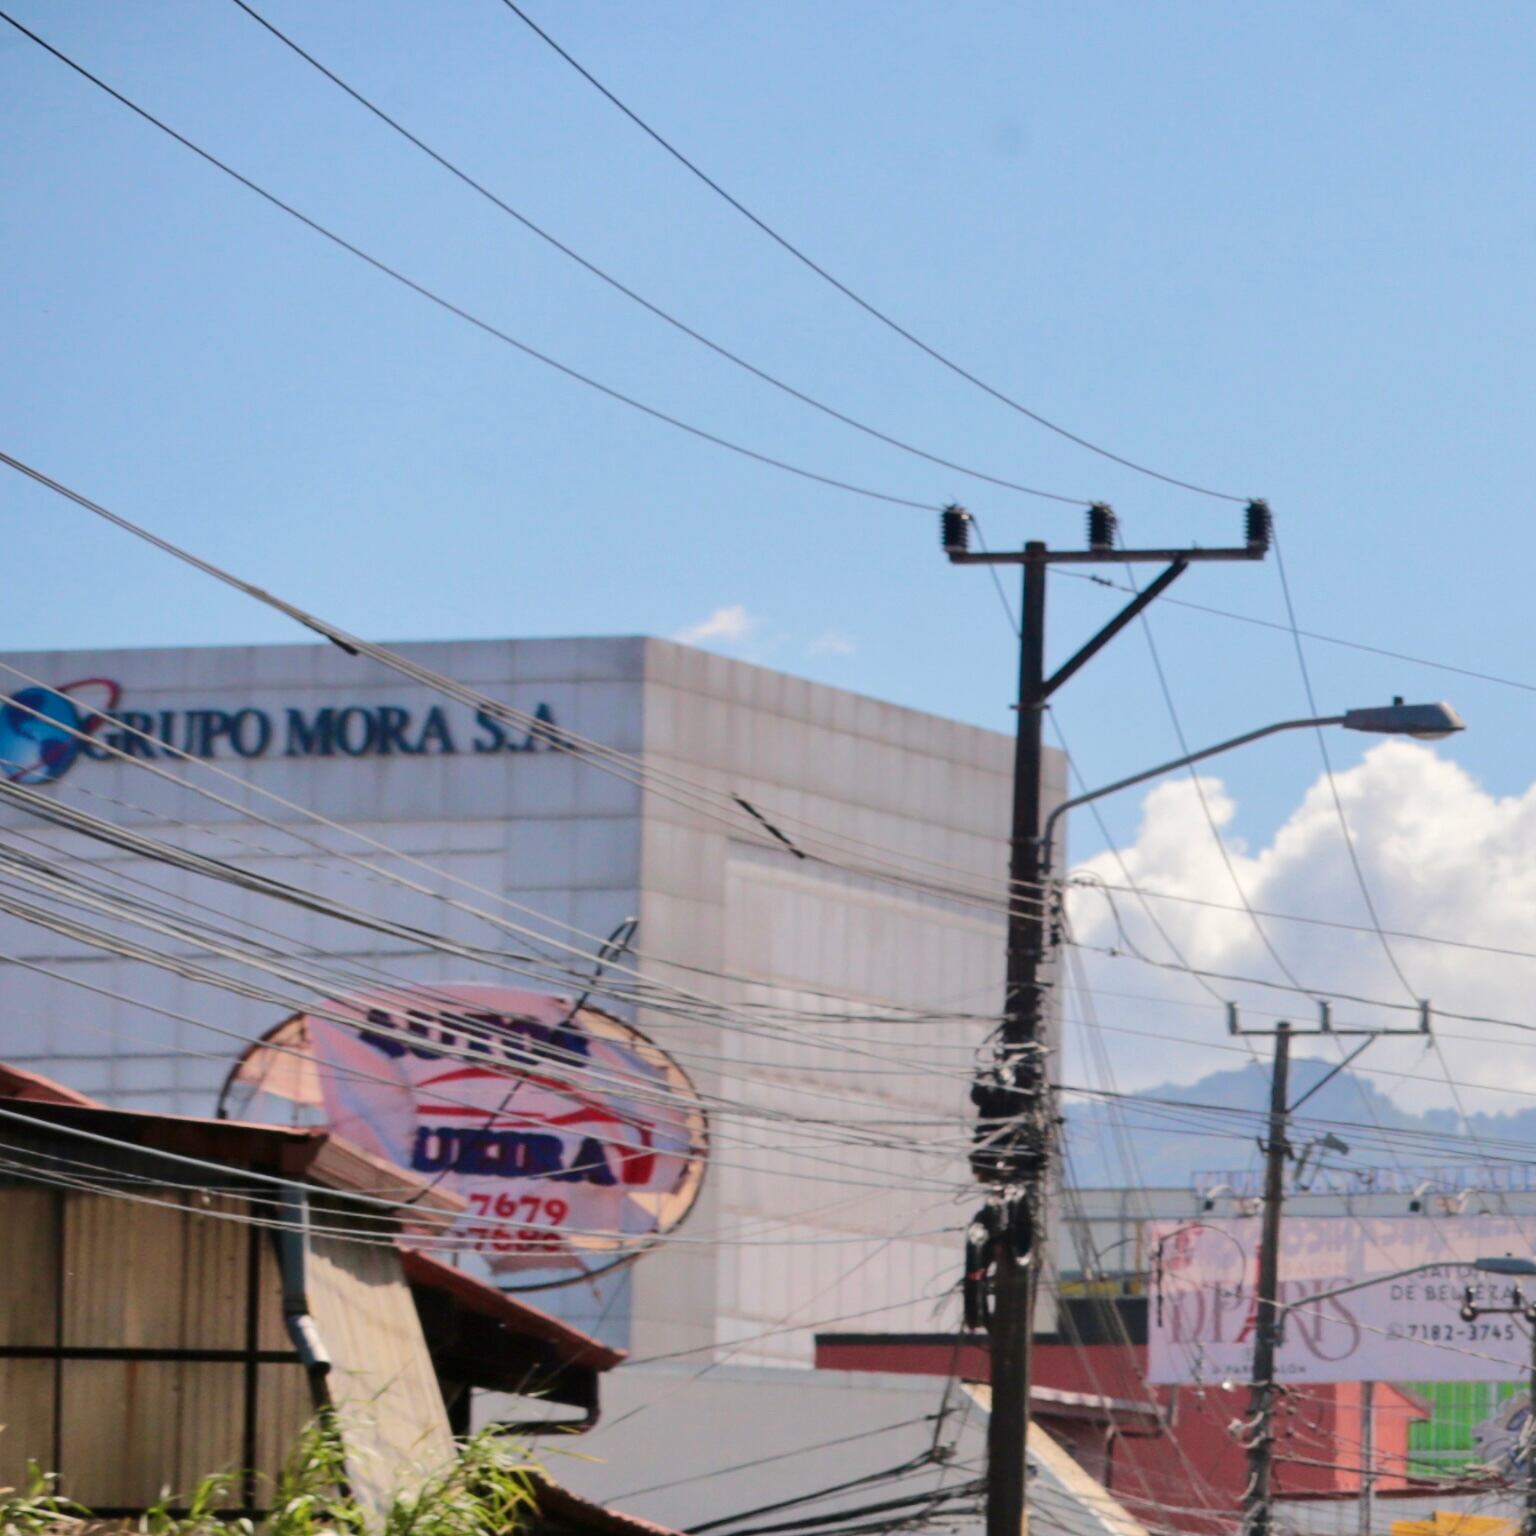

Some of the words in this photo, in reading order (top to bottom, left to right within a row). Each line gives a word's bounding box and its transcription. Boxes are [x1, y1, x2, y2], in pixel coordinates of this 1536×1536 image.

[77, 706, 271, 760] GRUPO
[285, 704, 457, 755] MORA
[470, 1193, 568, 1228] 7679
[1390, 1285, 1415, 1301] DE
[1424, 1285, 1517, 1301] BELEZA
[1408, 1324, 1515, 1341] 7182-3745
